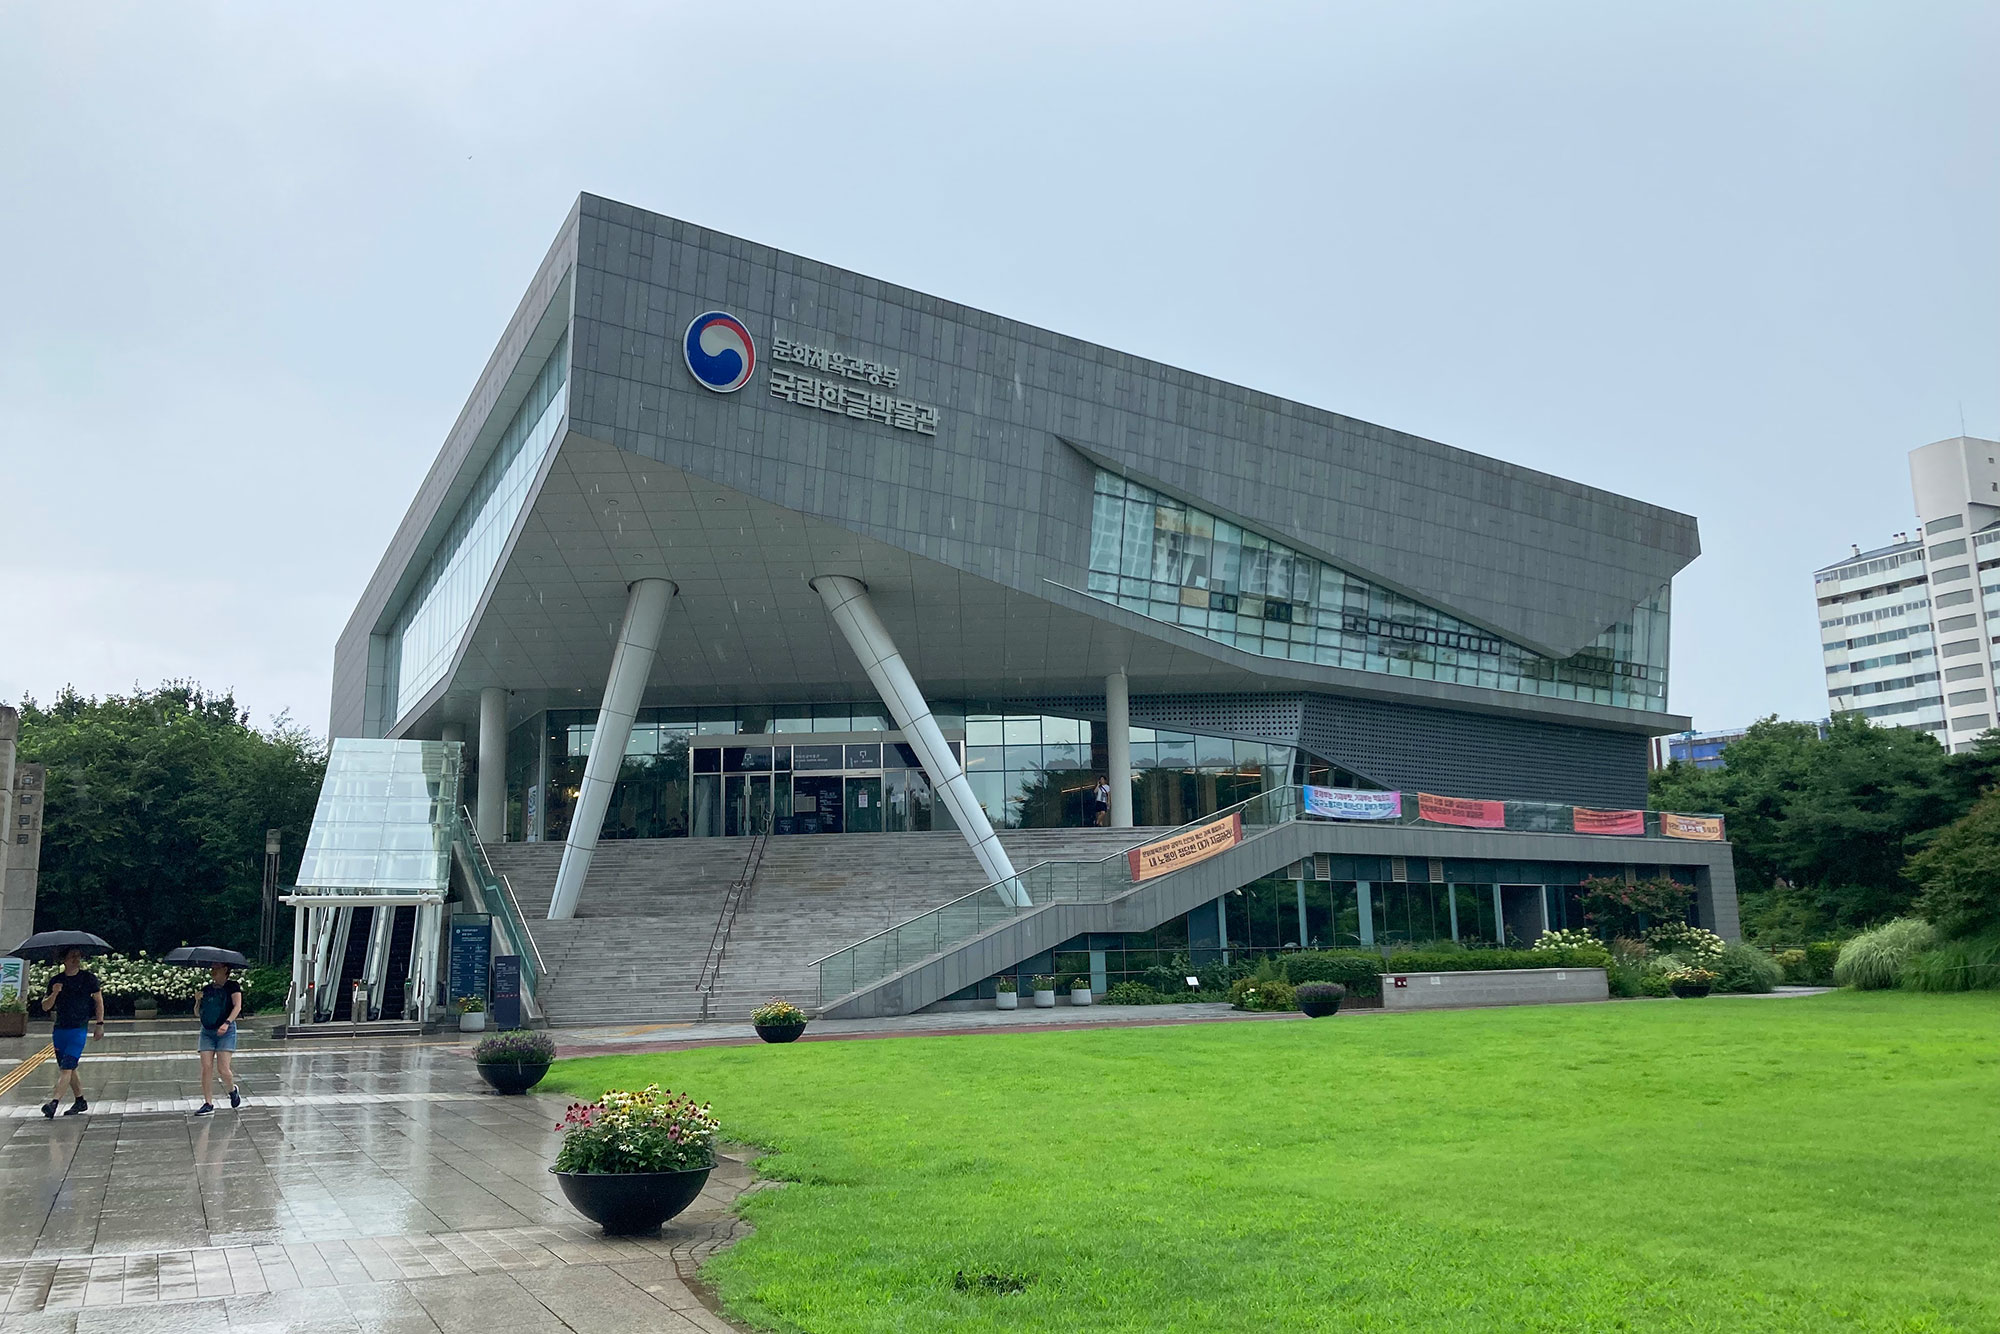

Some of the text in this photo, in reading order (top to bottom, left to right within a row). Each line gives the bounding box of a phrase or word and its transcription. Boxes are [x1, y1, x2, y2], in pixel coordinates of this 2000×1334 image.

[772, 336, 900, 389] 문화체육관광부
[769, 367, 940, 436] 국립한글박물관
[1158, 851, 1176, 864] 노동의
[1177, 843, 1198, 858] 정당한
[1197, 838, 1210, 851] 대가
